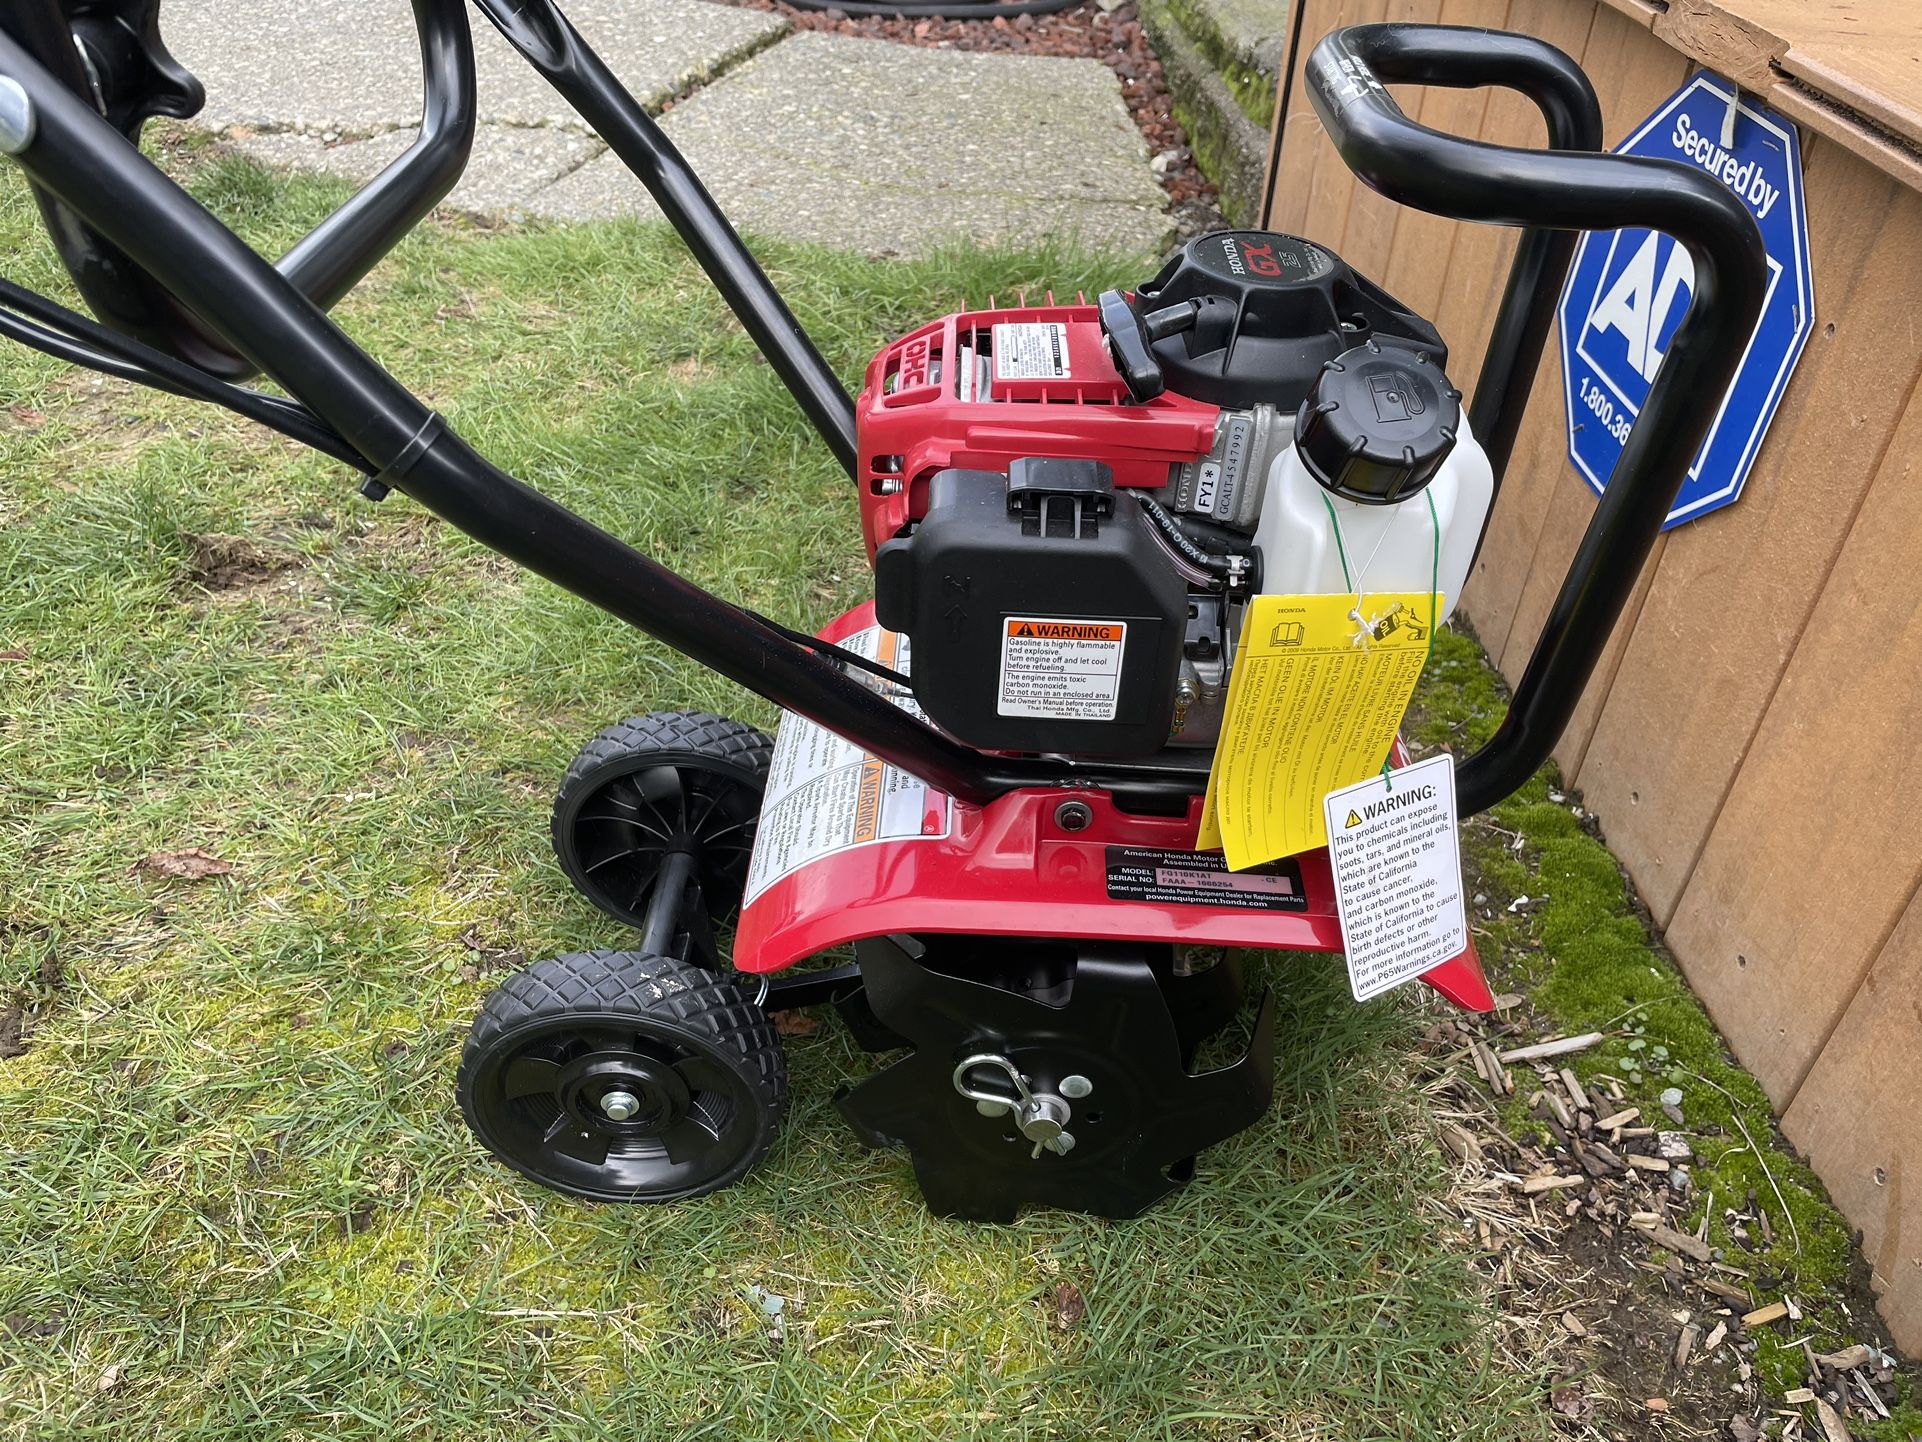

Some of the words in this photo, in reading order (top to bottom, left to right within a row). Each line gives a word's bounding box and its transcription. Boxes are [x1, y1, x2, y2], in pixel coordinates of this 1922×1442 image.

[1672, 114, 1751, 199] Secured
[1750, 166, 1779, 219] by
[1221, 237, 1245, 275] HONDA
[1239, 240, 1282, 277] GX
[1590, 230, 1695, 384] AD
[902, 340, 927, 388] OHC
[1579, 376, 1631, 446] 1.800.36
[1036, 624, 1110, 639] WARNING
[1379, 620, 1391, 637] OIL
[1008, 637, 1042, 647] Gasoline
[1043, 639, 1050, 649] is
[1051, 639, 1075, 650] highly
[1076, 640, 1115, 650] flammable
[1008, 646, 1023, 654] and
[1023, 647, 1061, 656] explosive.
[1007, 653, 1024, 663] Turn
[1025, 654, 1051, 664] engine
[1051, 656, 1063, 665] off
[1063, 656, 1078, 664] and
[1079, 657, 1090, 665] let
[1007, 661, 1031, 670] before
[1392, 651, 1409, 679] before
[1403, 650, 1416, 664] Fill
[1414, 650, 1425, 667] NO
[1006, 672, 1020, 680] The
[1021, 673, 1046, 682] engine
[1047, 675, 1067, 683] emits
[1069, 675, 1086, 683] toxic
[1377, 653, 1393, 687] MOTEUR
[1398, 664, 1410, 679] the
[1404, 670, 1416, 687] OIL
[1005, 680, 1030, 688] carbon
[1031, 680, 1069, 690] monoxide.
[1005, 687, 1015, 695] Do
[1043, 689, 1051, 697] in
[1061, 690, 1094, 699] enclosed
[1386, 680, 1402, 708] engine
[1397, 689, 1409, 701] IN
[1001, 696, 1017, 704] Read
[1017, 697, 1041, 705] Owner's
[1042, 698, 1065, 706] Manual
[1065, 699, 1084, 707] before
[1366, 688, 1379, 708] LIVRE
[1377, 680, 1396, 711] starting
[1359, 710, 1371, 730] SANS
[1373, 712, 1383, 725] the
[1379, 709, 1390, 727] with
[1383, 704, 1401, 743] ENGINE
[1351, 732, 1362, 752] HUILE
[1361, 727, 1377, 756] engine.
[1375, 729, 1383, 740] oil
[1371, 741, 1379, 750] to
[1365, 751, 1376, 763] the
[858, 777, 879, 837] WARNING
[1363, 784, 1436, 820] WARNING:
[1334, 833, 1354, 846] This
[1355, 820, 1388, 841] product
[1389, 814, 1406, 826] can
[1407, 803, 1438, 820] expose
[1337, 847, 1354, 860] you
[1355, 843, 1365, 852] to
[1366, 825, 1408, 848] chemicals
[1410, 811, 1448, 831] including
[1122, 849, 1163, 858] American
[1163, 852, 1191, 860] Honda
[1192, 854, 1218, 862] Motor
[1339, 857, 1364, 871] soots,
[1365, 849, 1384, 861] tars,
[1386, 839, 1401, 853] and
[1402, 827, 1433, 846] mineral
[1434, 823, 1451, 834] oils,
[1121, 867, 1154, 875] MODEL:
[1162, 858, 1208, 868] Assembled
[1340, 867, 1366, 883] which
[1368, 862, 1382, 873] are
[1383, 850, 1410, 866] known
[1411, 846, 1420, 855] to
[1421, 840, 1435, 851] the
[1108, 873, 1137, 882] SERIAL
[1342, 881, 1365, 895] State
[1367, 874, 1376, 886] of
[1378, 859, 1417, 881] California
[1145, 894, 1268, 907] powerequipment.honda.com
[1344, 898, 1353, 907] to
[1355, 887, 1381, 903] cause
[1382, 874, 1413, 892] cancer,
[1346, 905, 1363, 919] and
[1364, 894, 1394, 912] carbon
[1395, 877, 1438, 900] monoxide,
[1348, 915, 1373, 931] which
[1374, 912, 1382, 921] is
[1383, 901, 1410, 917] known
[1411, 897, 1420, 906] to
[1421, 890, 1435, 901] the
[1350, 929, 1373, 943] State
[1374, 922, 1383, 933] of
[1385, 907, 1424, 929] California
[1425, 903, 1434, 912] to
[1436, 892, 1458, 908] cause
[1351, 940, 1372, 955] birth
[1373, 928, 1405, 946] defects
[1406, 923, 1415, 933] or
[1417, 913, 1438, 928] other
[1354, 940, 1406, 967] reproductive
[1407, 930, 1431, 945] harm.
[1355, 966, 1369, 979] For
[1371, 957, 1393, 972] more
[1395, 937, 1440, 962] information
[1441, 931, 1451, 943] go
[1452, 927, 1460, 935] to
[1358, 940, 1457, 991] www.P65Warnings.ca.gov.
